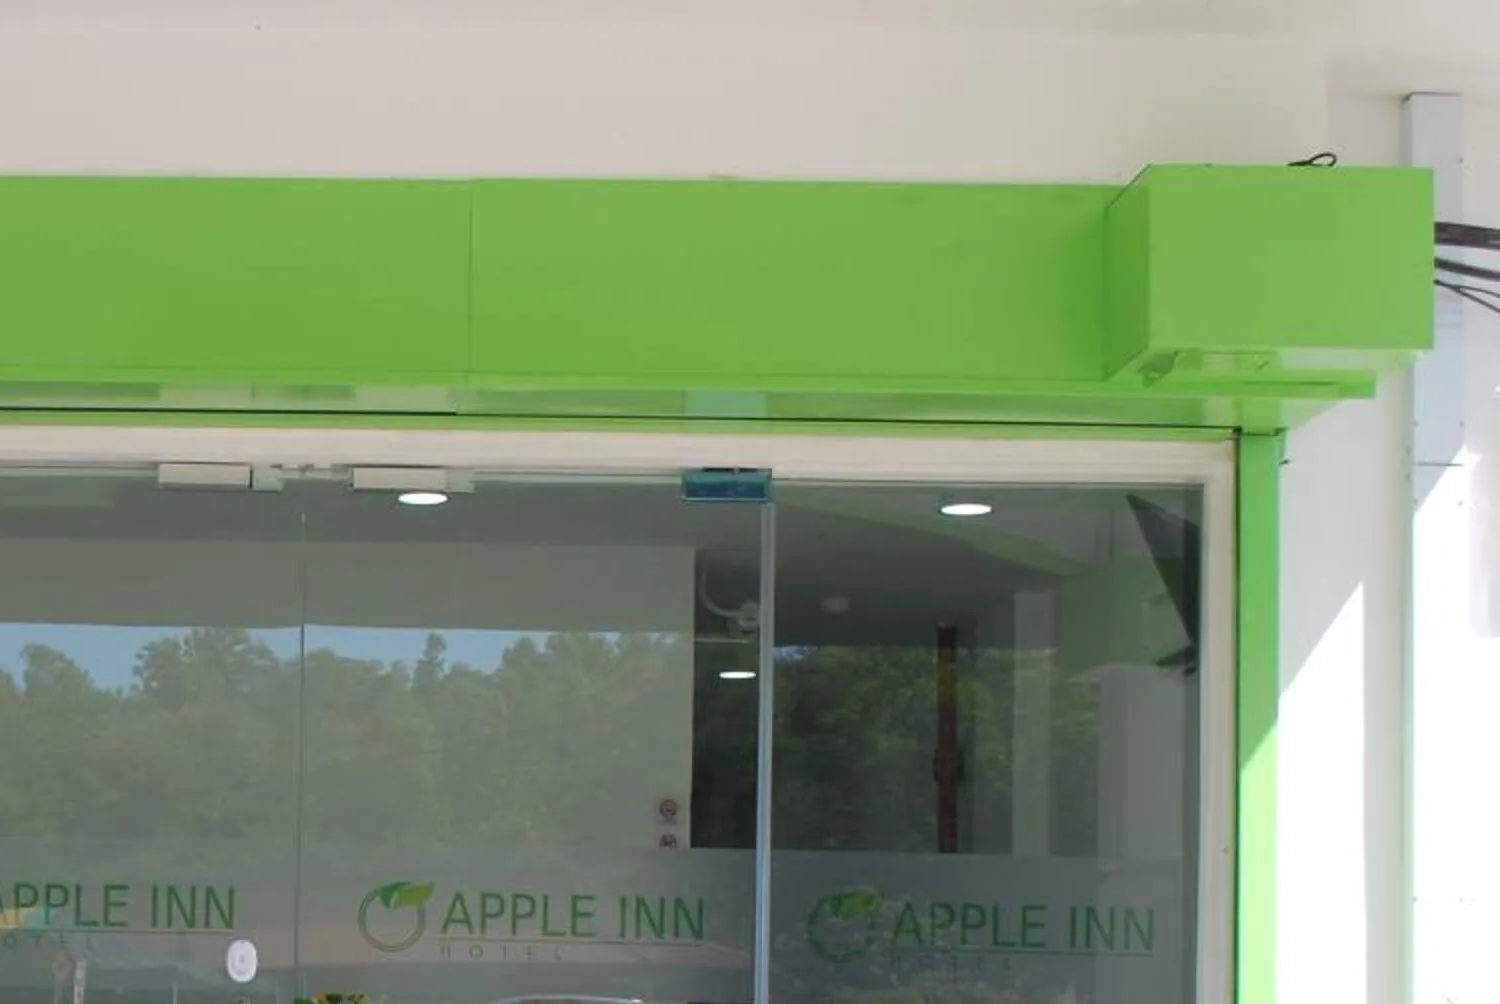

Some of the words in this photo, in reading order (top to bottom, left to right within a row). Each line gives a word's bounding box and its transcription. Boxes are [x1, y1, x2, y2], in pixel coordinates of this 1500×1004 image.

[151, 884, 236, 930] INN
[441, 890, 598, 938] APPLE
[617, 894, 706, 940] INN
[890, 899, 1048, 949] APPLE
[1068, 904, 1155, 952] INN
